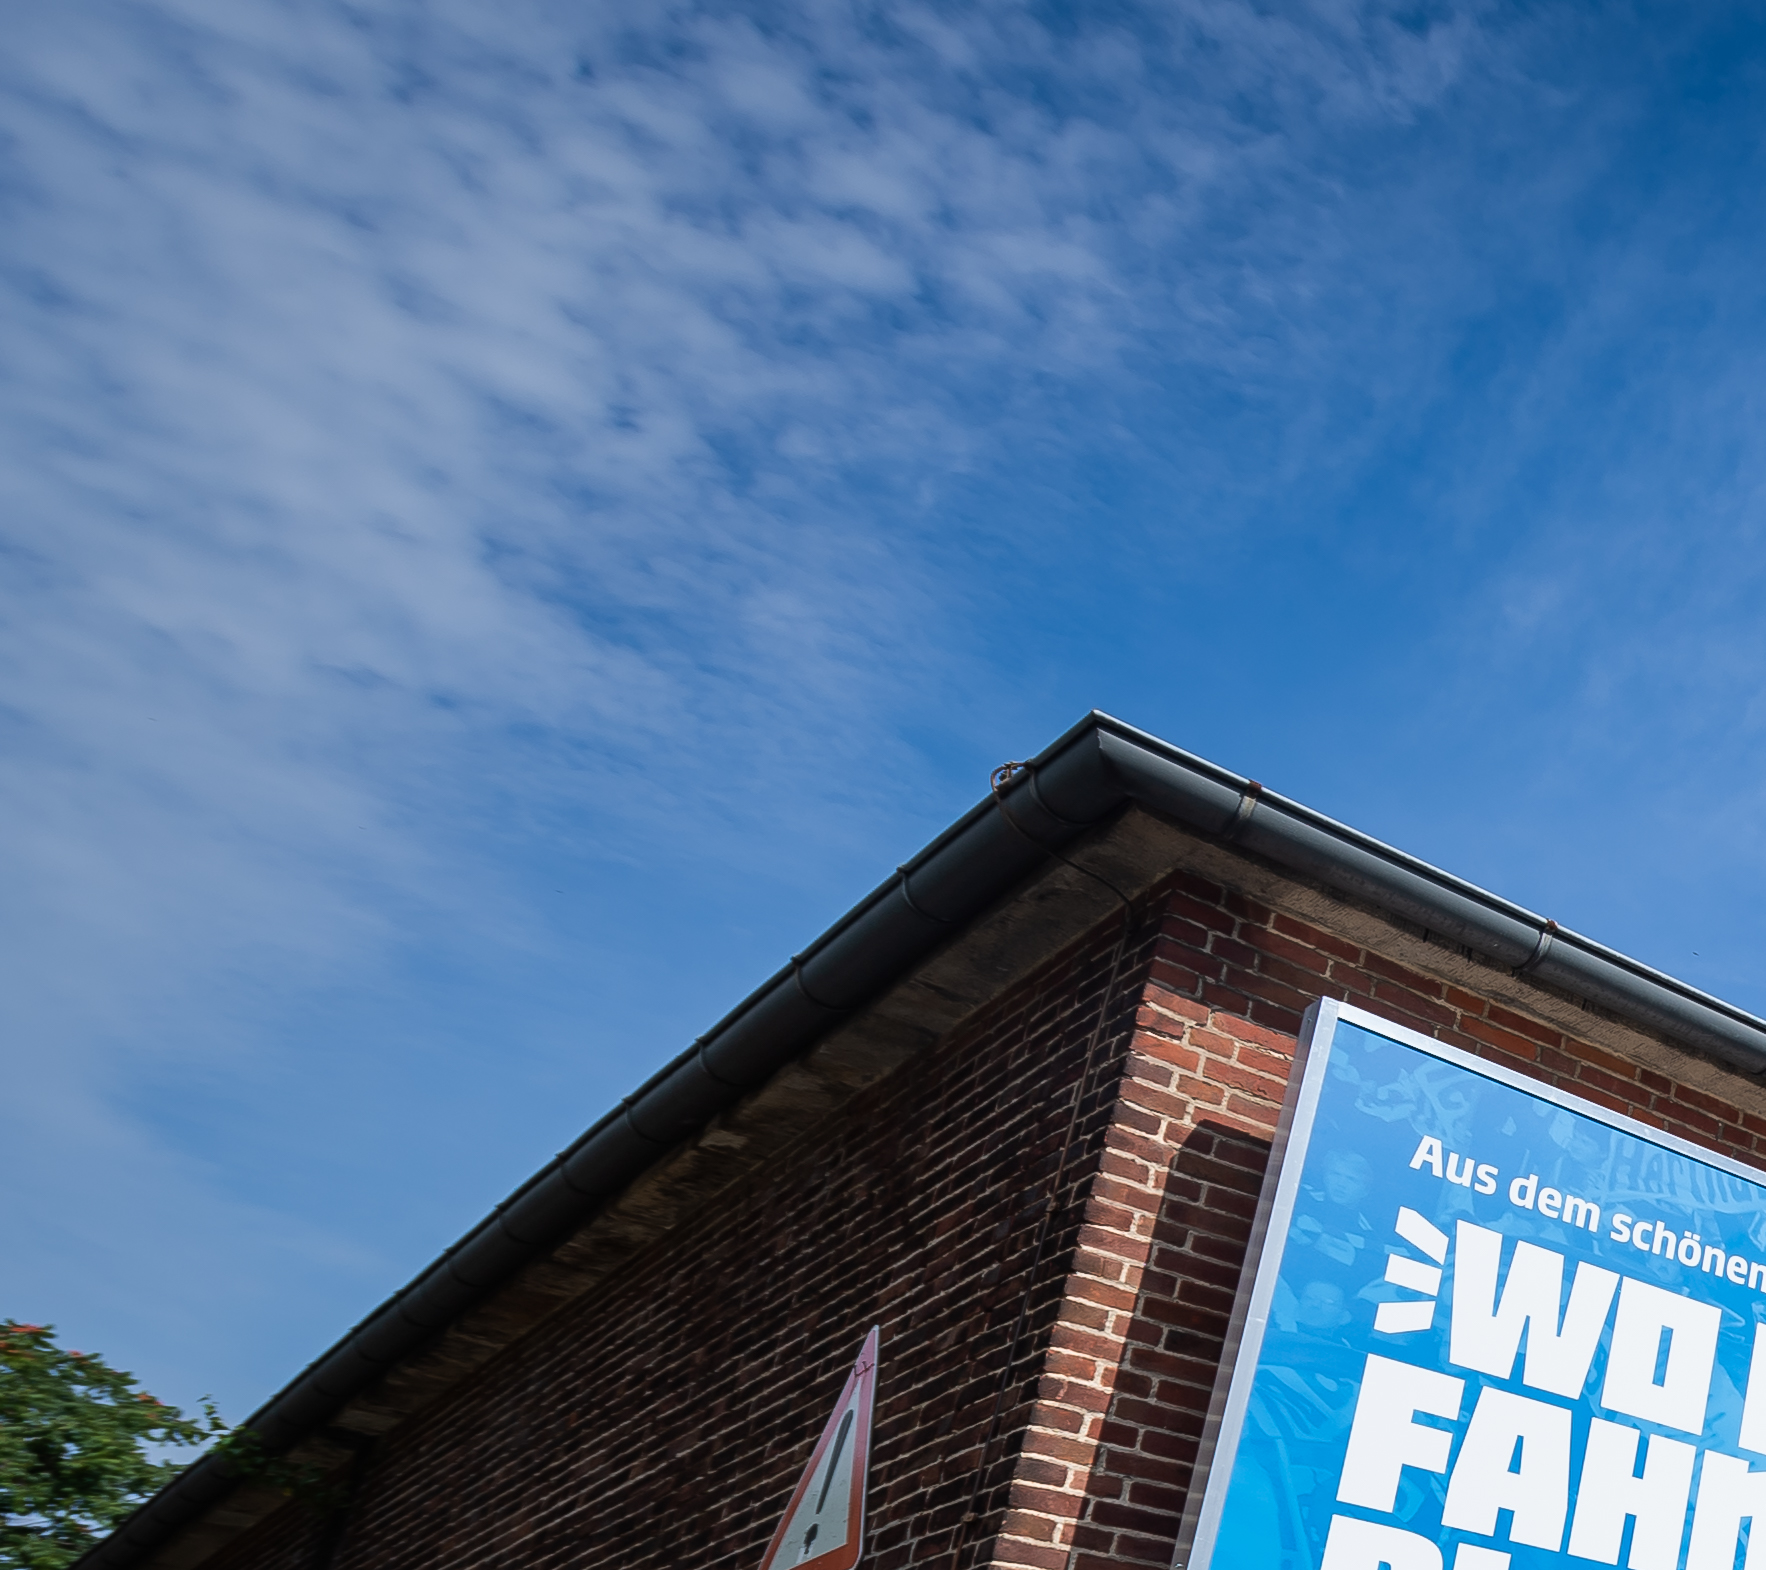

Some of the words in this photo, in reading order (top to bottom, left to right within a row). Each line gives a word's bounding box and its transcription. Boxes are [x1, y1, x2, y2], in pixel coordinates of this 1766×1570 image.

[1408, 1134, 1500, 1196] Aus
[1509, 1172, 1600, 1233] dem
[1449, 1219, 1722, 1436] WO
